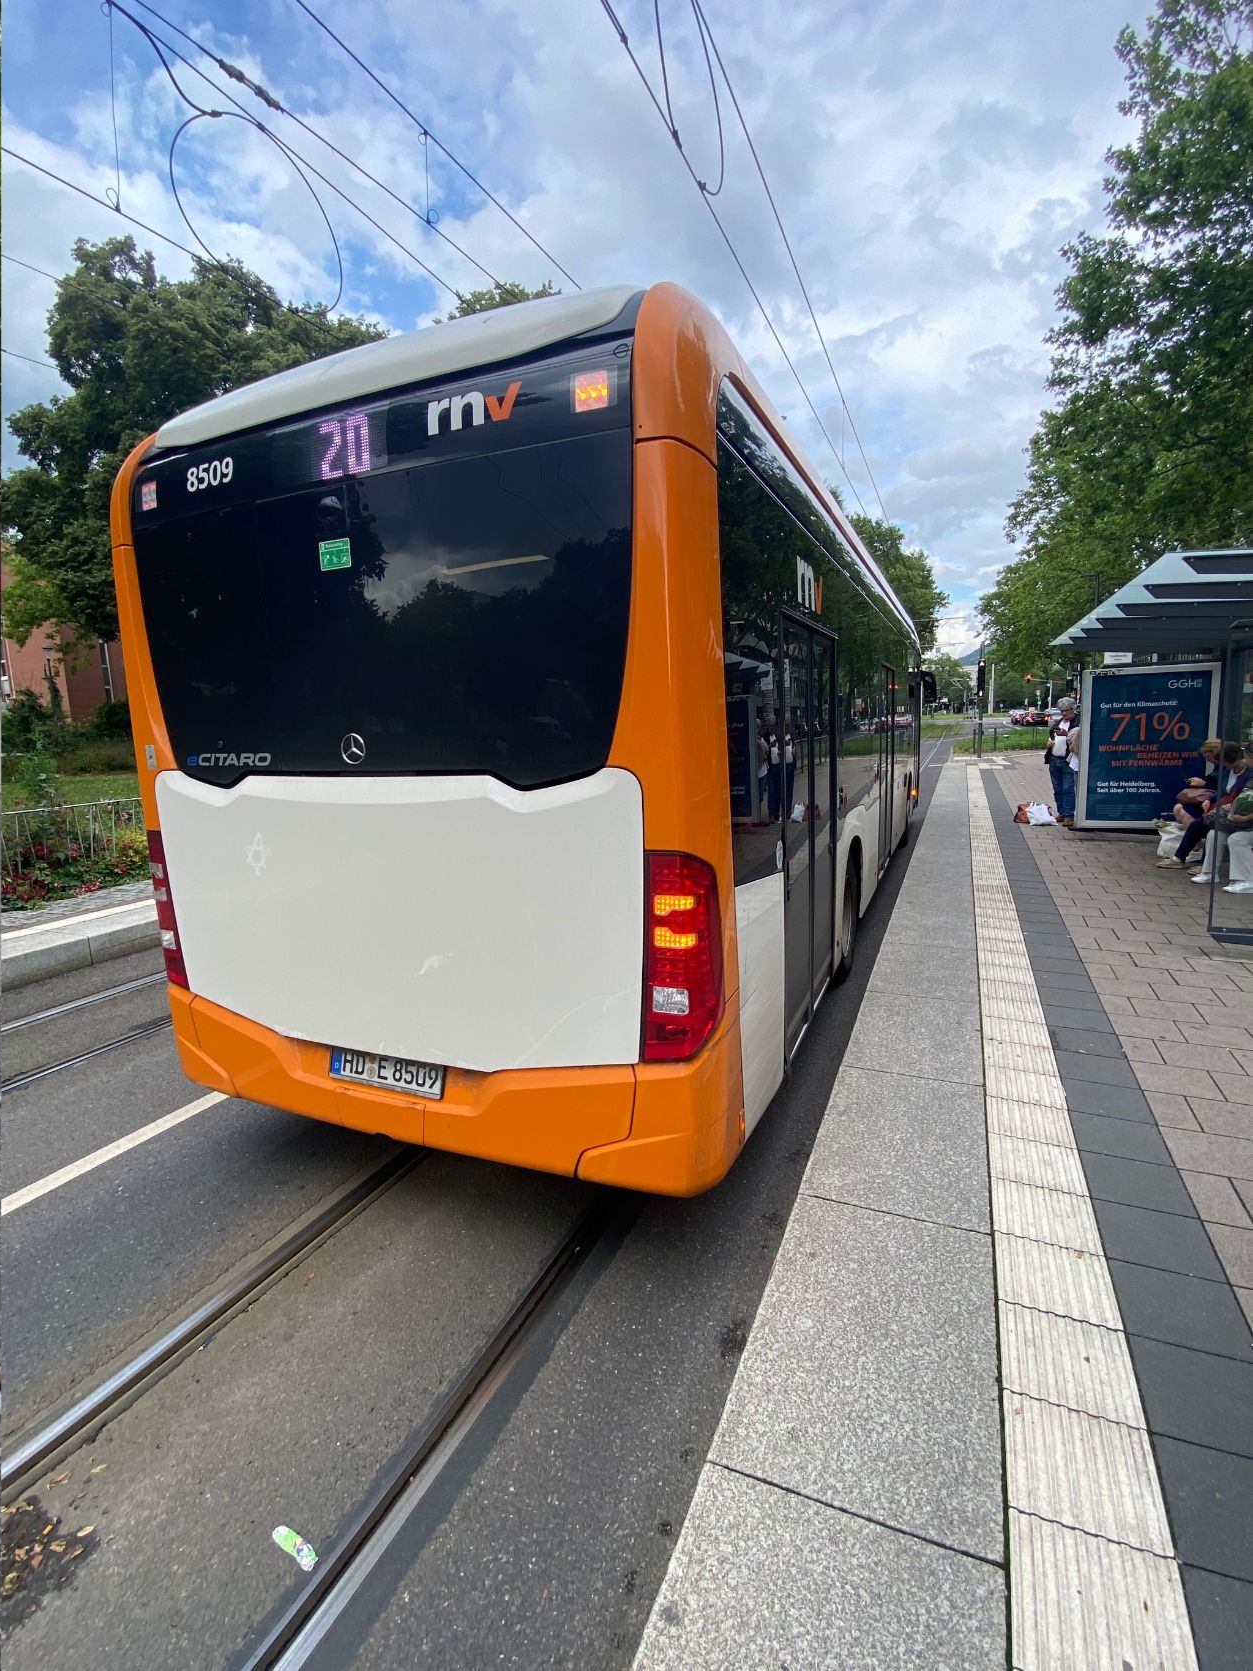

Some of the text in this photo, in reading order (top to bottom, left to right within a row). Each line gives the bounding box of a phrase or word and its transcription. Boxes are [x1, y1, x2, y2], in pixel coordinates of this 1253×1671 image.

[427, 381, 522, 436] rnv
[318, 413, 371, 480] 20
[187, 457, 234, 493] 8509
[1168, 679, 1197, 689] GGH
[1110, 710, 1190, 742] 71%
[1098, 744, 1159, 752] WOHNFLÄCHE
[1137, 751, 1199, 760] BEHEIZEN WIR
[186, 752, 271, 767] eCITARO
[1129, 758, 1184, 767] FERNWÄRME
[1110, 780, 1119, 788] für
[342, 1051, 439, 1090] HD E 8509
